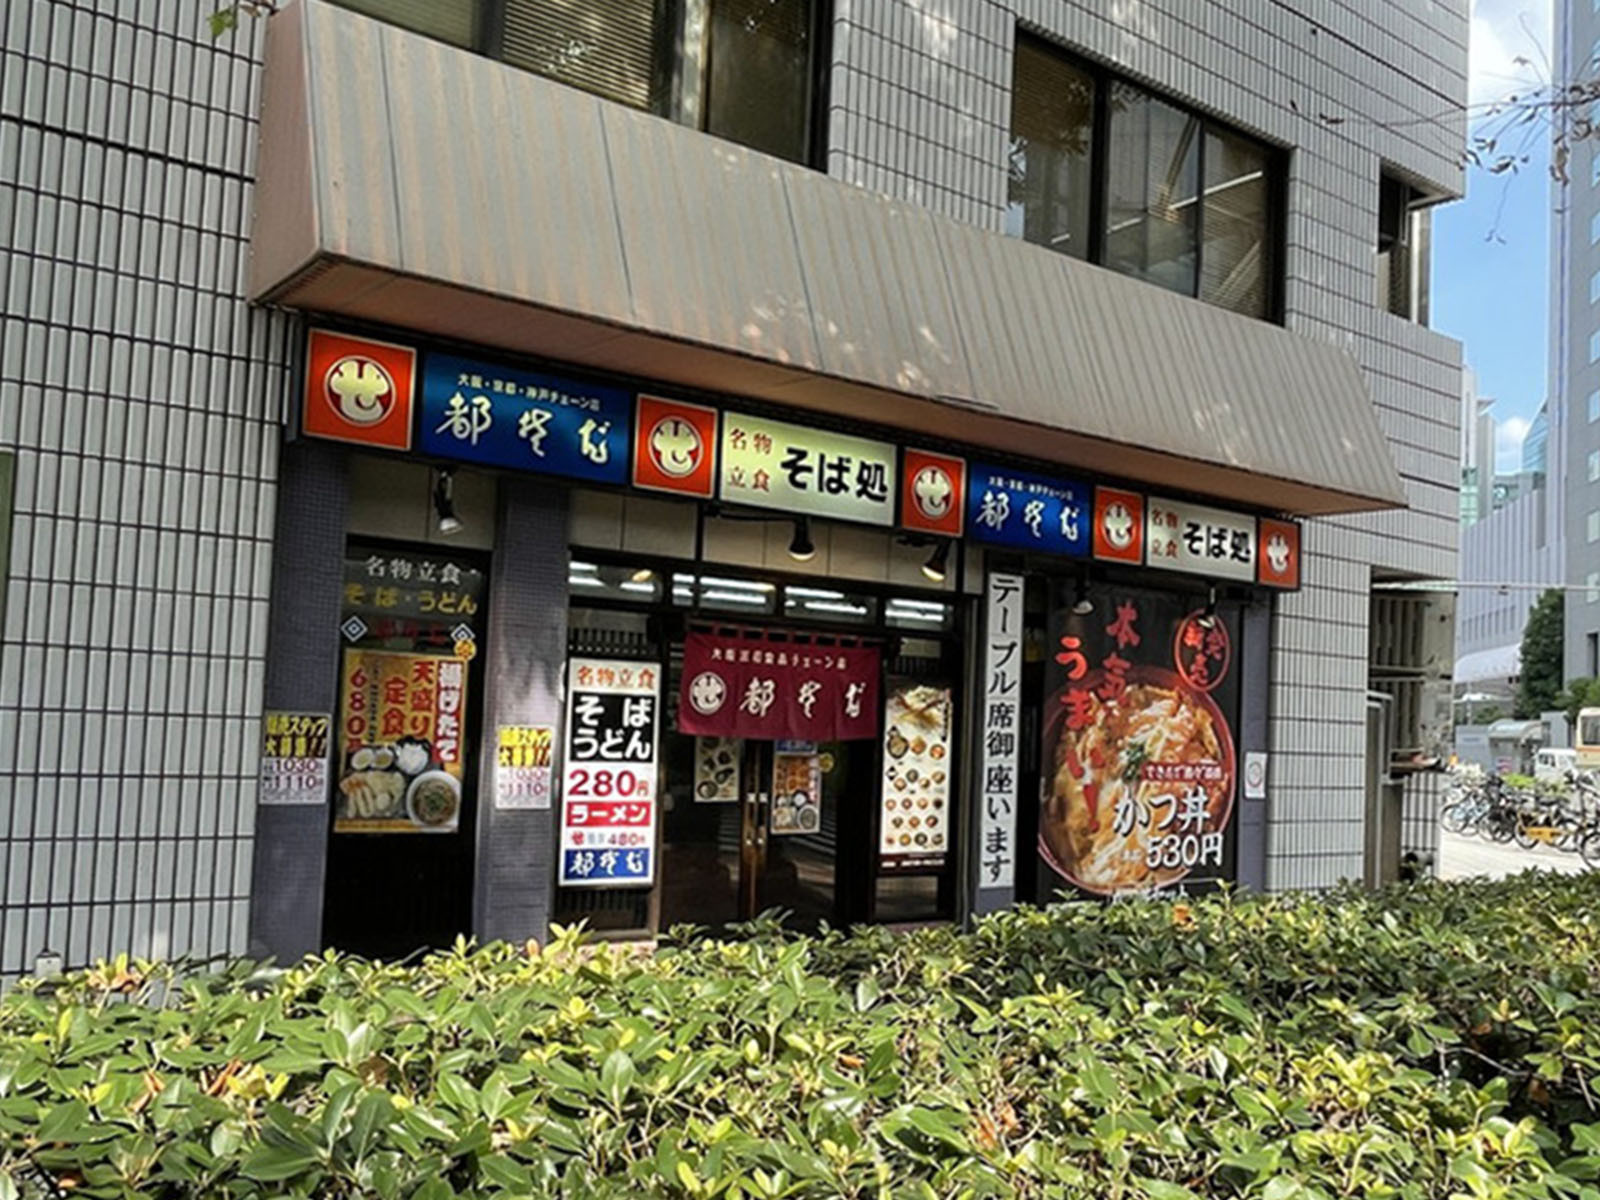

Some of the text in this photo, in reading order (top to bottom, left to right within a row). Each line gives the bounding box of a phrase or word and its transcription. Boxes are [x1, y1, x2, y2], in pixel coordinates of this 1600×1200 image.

[729, 428, 773, 455] 名物
[727, 466, 771, 493] 立食
[780, 447, 888, 503] そば処
[1152, 508, 1179, 529] 名物
[1151, 539, 1178, 559] 立食
[1183, 521, 1251, 563] そば処
[365, 555, 461, 585] 名物立食
[576, 665, 656, 691] 名物立食
[382, 676, 408, 737] 定食
[410, 661, 435, 738] 天盛り
[574, 695, 653, 727] そば
[573, 728, 651, 760] うどん
[984, 579, 1020, 883] テーブル席御座います
[568, 769, 649, 797] 280円
[570, 803, 647, 825] ラーメン
[1113, 785, 1211, 838] かつ丼
[1146, 832, 1224, 869] 530円
